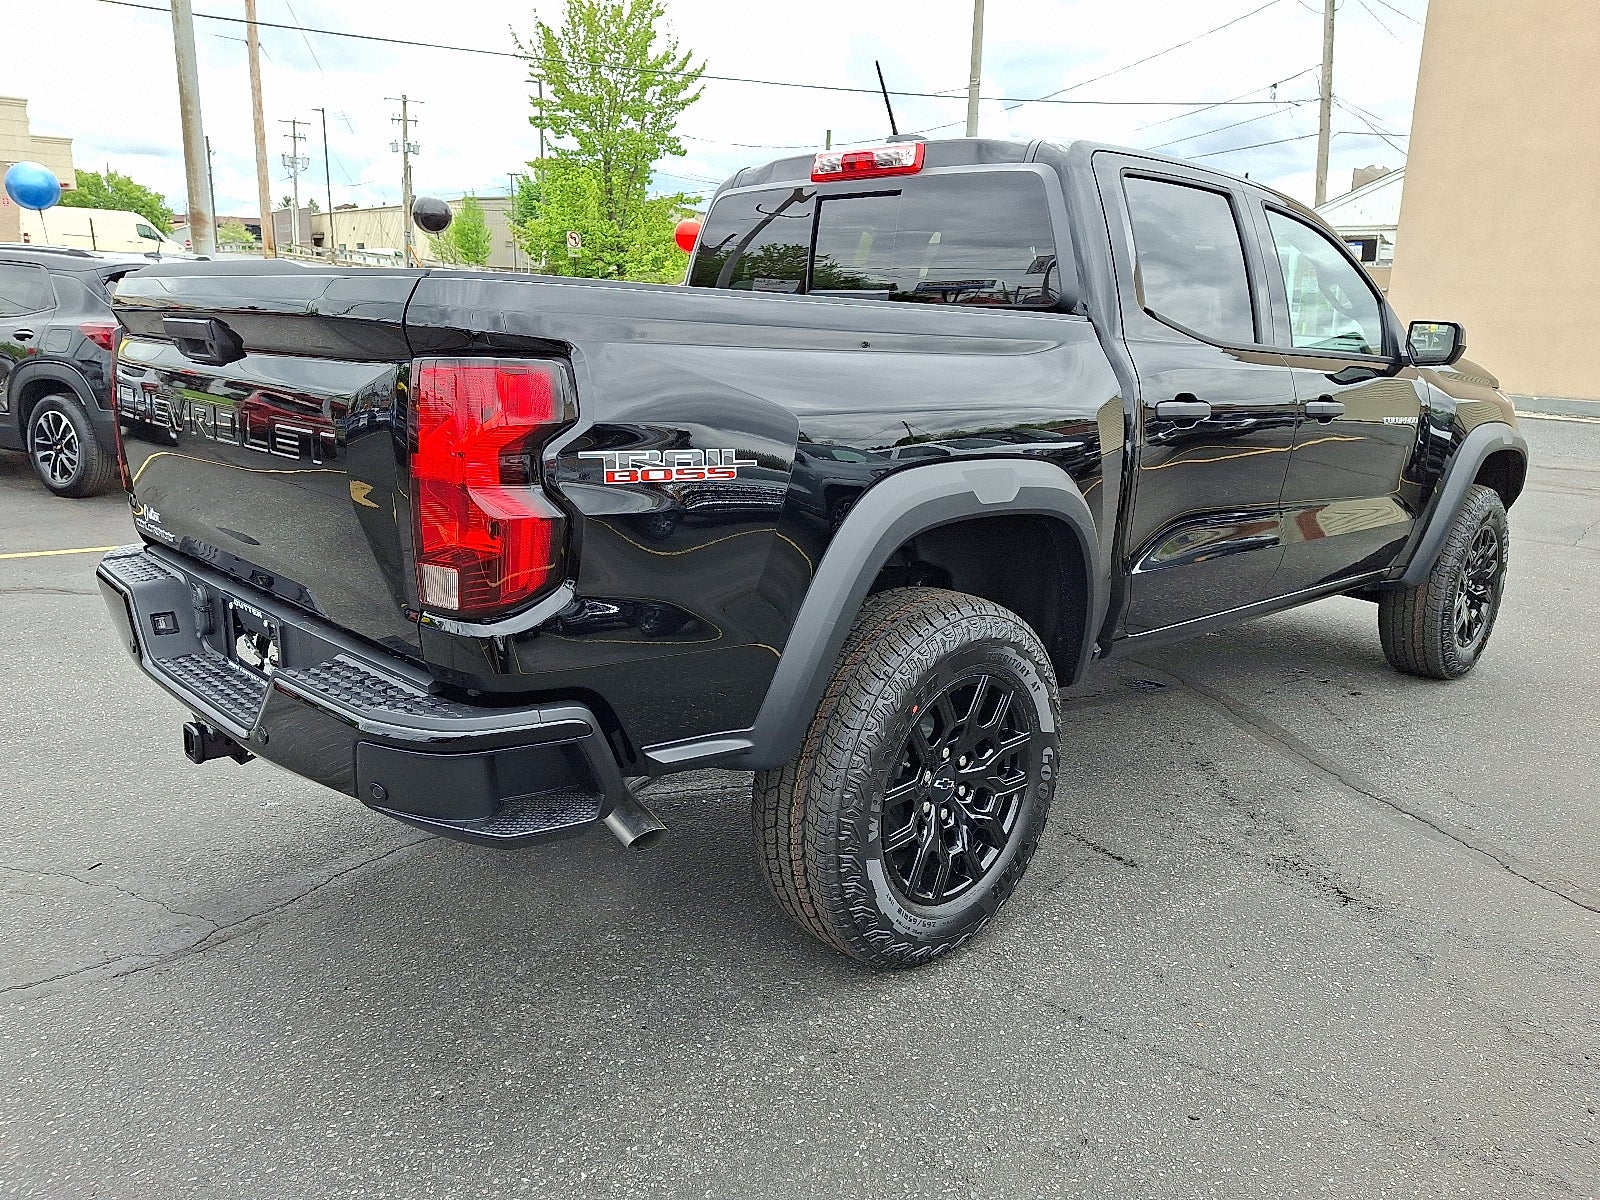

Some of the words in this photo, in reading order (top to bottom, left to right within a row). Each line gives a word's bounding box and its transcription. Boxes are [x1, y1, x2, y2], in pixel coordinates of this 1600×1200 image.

[118, 383, 338, 464] CHEVROLET
[578, 449, 758, 469] TRAIL
[604, 467, 737, 485] BOSS
